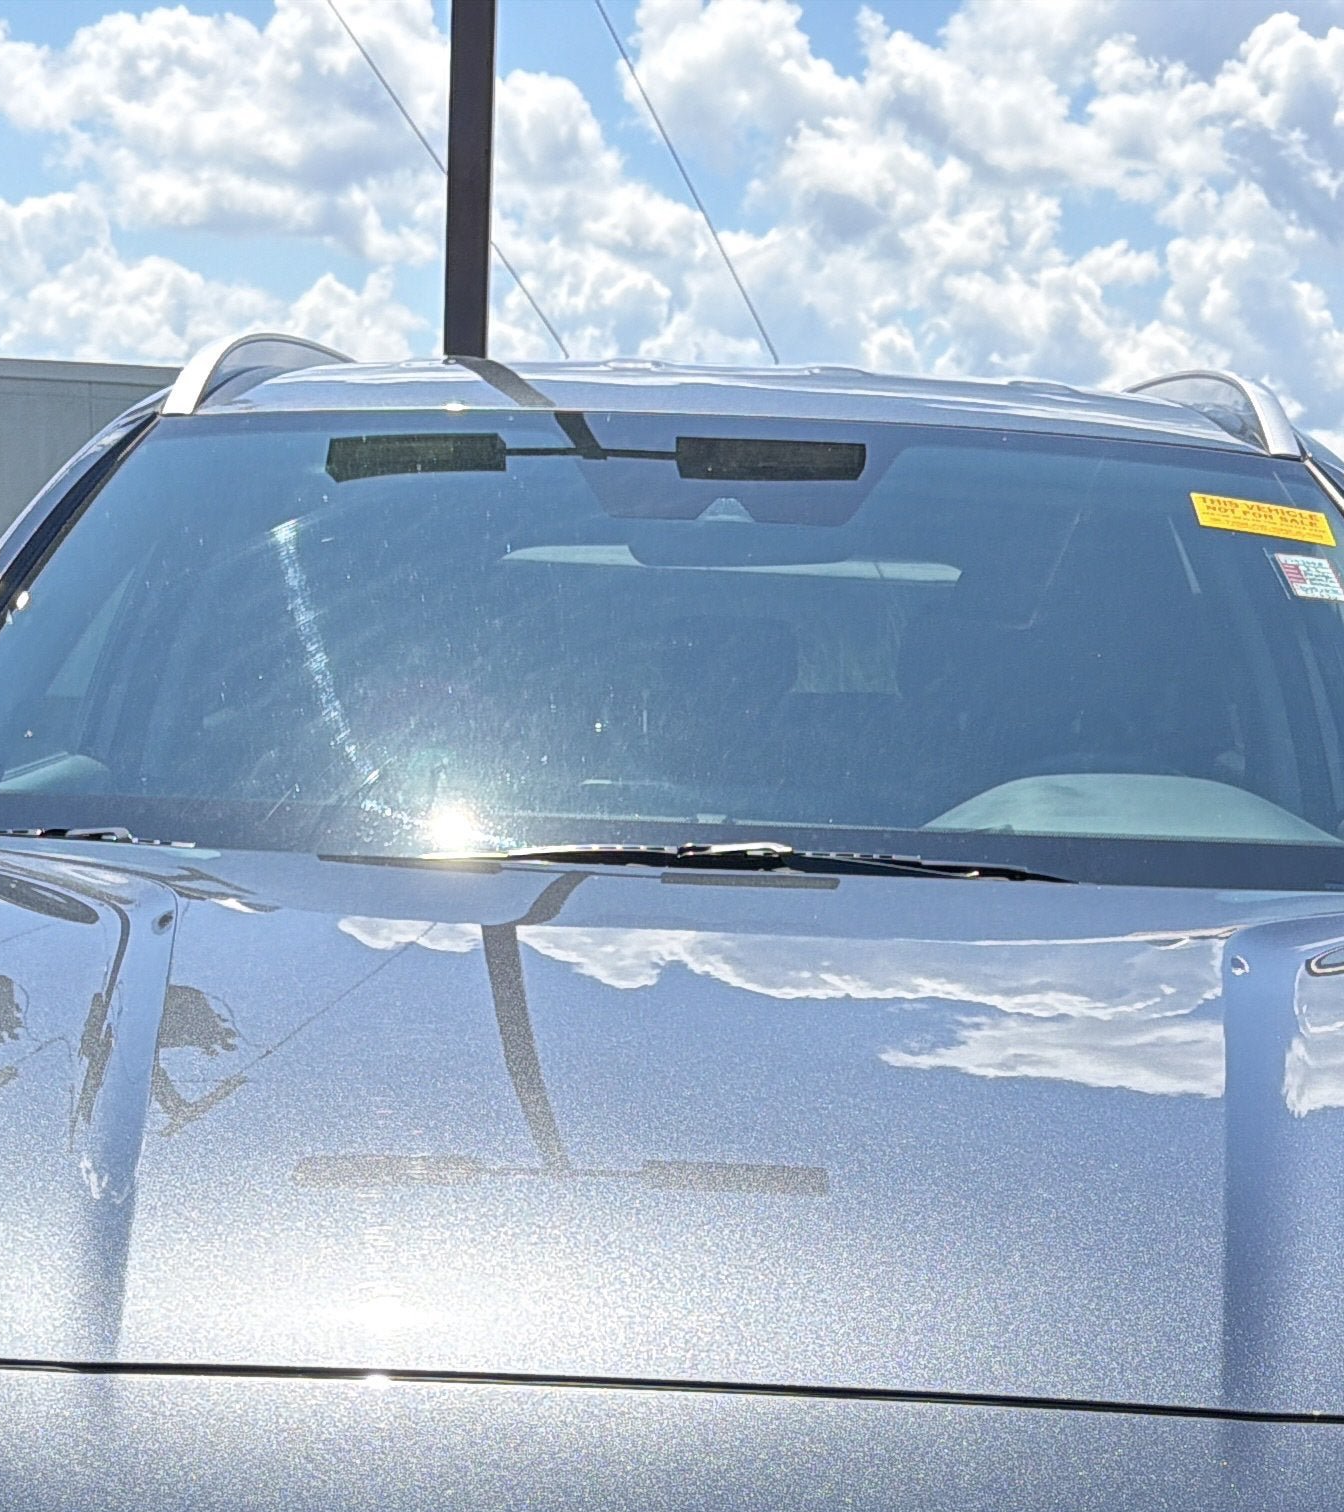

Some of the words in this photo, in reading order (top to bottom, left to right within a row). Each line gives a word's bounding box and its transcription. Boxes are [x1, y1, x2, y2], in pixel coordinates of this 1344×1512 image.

[1201, 496, 1238, 509] THIS
[1244, 503, 1319, 521] VEHICLE
[1206, 505, 1237, 515] NOT
[1242, 510, 1274, 520] FOR
[1279, 516, 1318, 527] SALE
